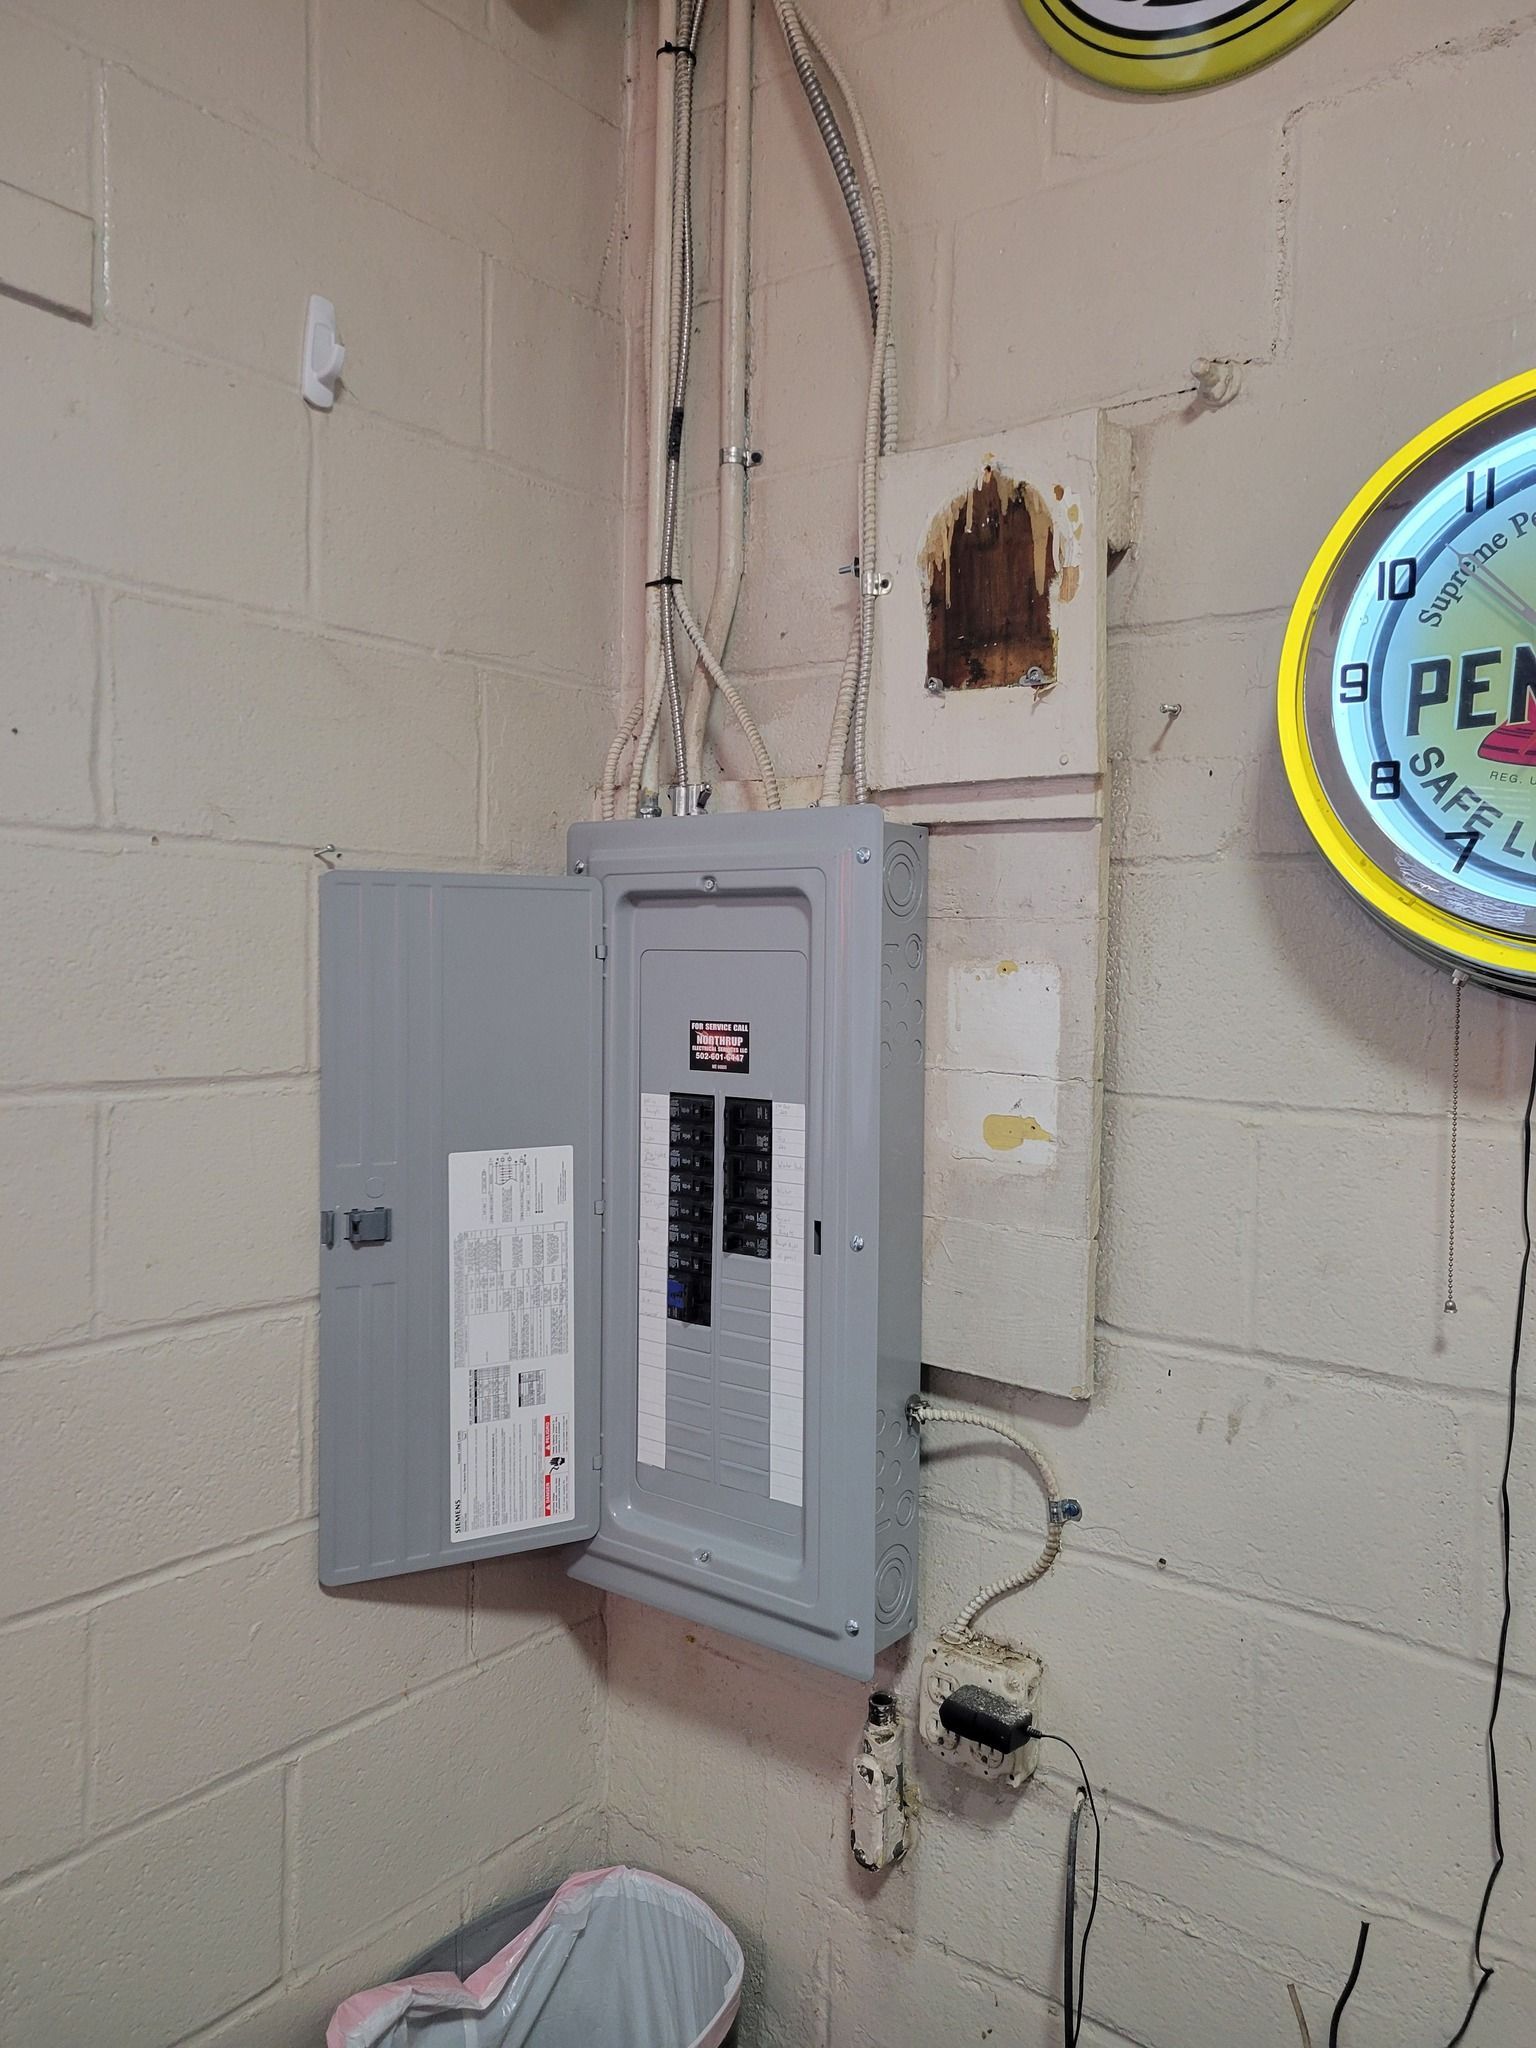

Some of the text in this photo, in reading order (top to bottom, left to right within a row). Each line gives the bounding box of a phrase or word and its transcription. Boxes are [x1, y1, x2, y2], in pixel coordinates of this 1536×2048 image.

[1465, 467, 1496, 513] 11
[1377, 557, 1417, 601] 10
[1418, 533, 1508, 627] Supreme
[1339, 662, 1369, 703] 9
[1370, 760, 1401, 800] 8
[1489, 770, 1523, 784] REG.
[1409, 746, 1536, 863] SAFE L
[1444, 831, 1480, 874] 7
[696, 1035, 743, 1046] NORTHRUP
[705, 1023, 731, 1031] SERVICE
[733, 1024, 748, 1032] CALL
